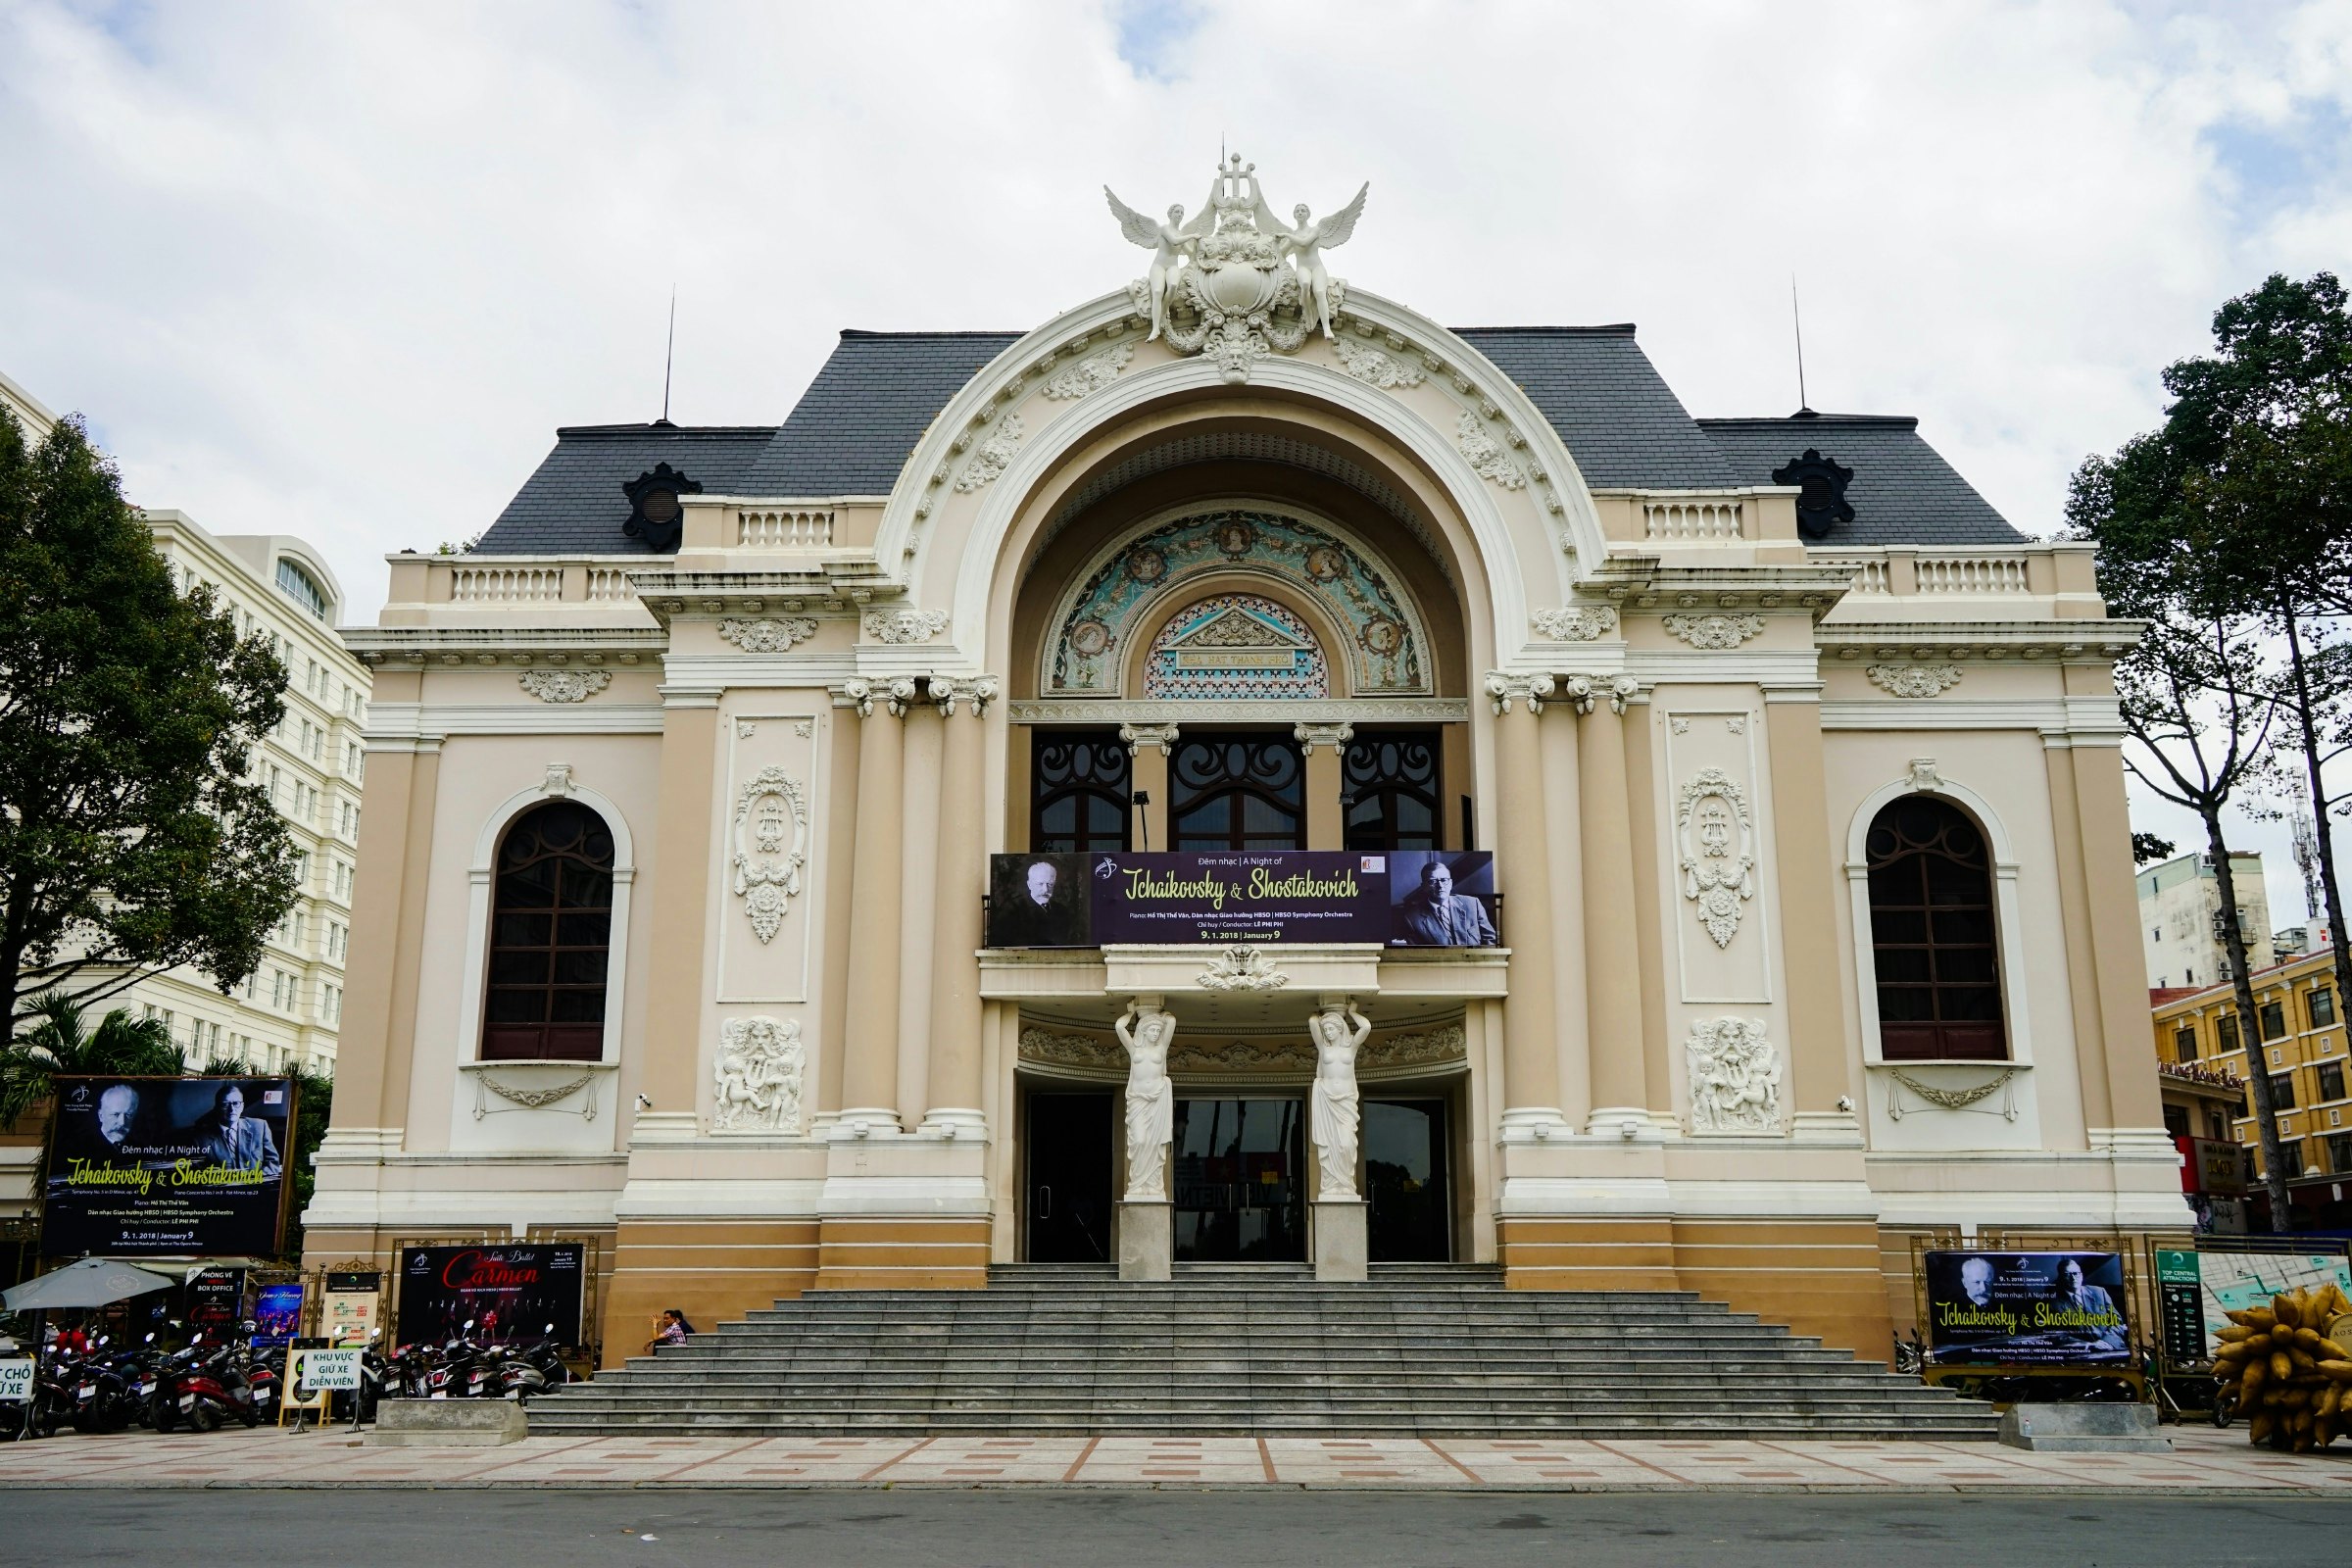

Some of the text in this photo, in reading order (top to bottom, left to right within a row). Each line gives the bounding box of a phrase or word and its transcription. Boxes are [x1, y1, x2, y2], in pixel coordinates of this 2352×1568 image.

[1218, 858, 1238, 867] nhạc
[1250, 858, 1273, 866] Night
[1122, 867, 1359, 910] Tchaikovsky & Shostakovich
[1243, 932, 1273, 941] January
[1273, 930, 1281, 939] 9
[122, 1145, 142, 1154] Đêm
[143, 1145, 165, 1155] nhạc
[177, 1145, 201, 1155] Night
[202, 1145, 211, 1154] of
[67, 1157, 265, 1195] Tchaikovsky & Shostakovich
[442, 1250, 542, 1289] Carmen
[2033, 1292, 2049, 1300] Night
[1936, 1301, 2121, 1336] Tchaikovsky & Shostakovich
[334, 1352, 354, 1362] VỰC
[5, 1363, 31, 1380] CHỖ
[337, 1365, 349, 1374] XE
[8, 1383, 23, 1395] XE
